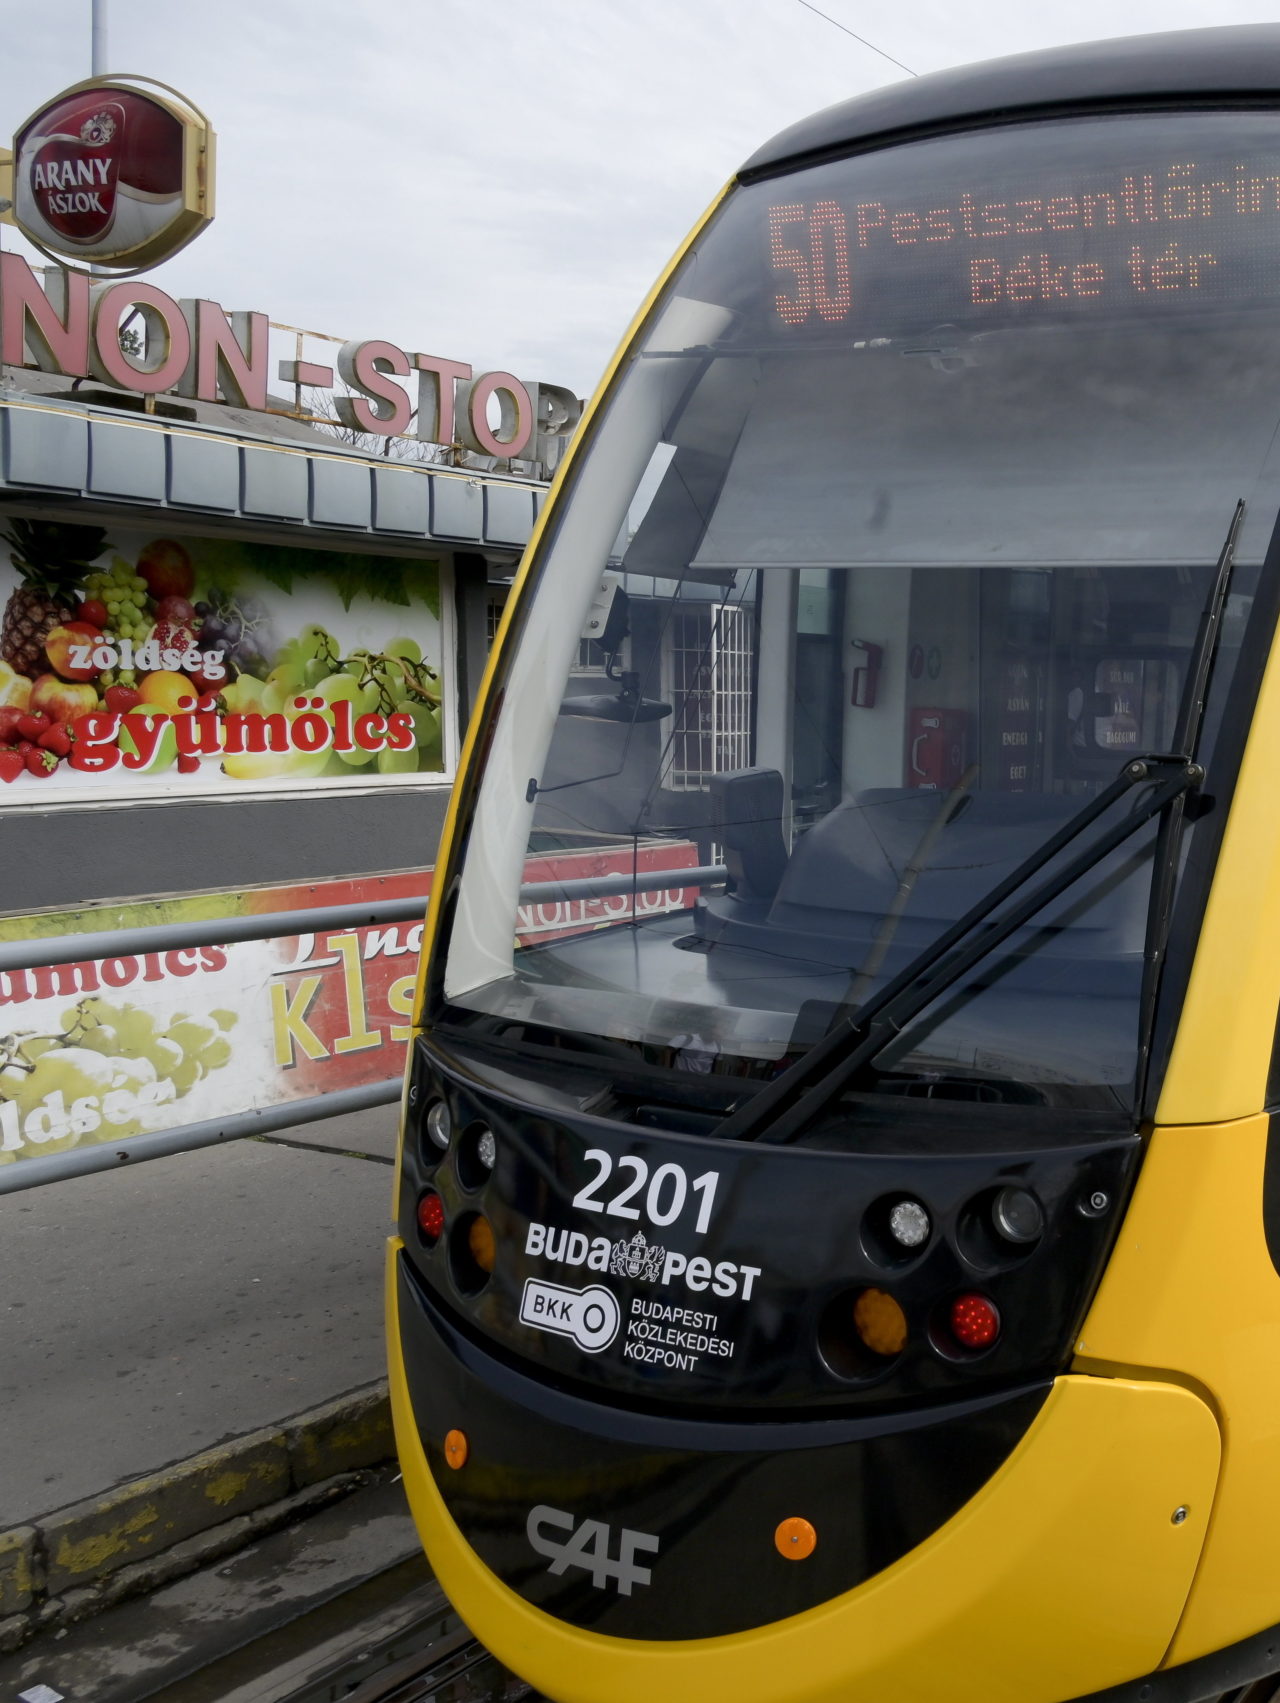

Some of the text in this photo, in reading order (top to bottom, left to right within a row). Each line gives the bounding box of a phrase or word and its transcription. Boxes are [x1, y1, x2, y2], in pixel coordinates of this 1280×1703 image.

[35, 159, 112, 191] ARANY
[47, 190, 108, 215] ÁSZOK
[768, 200, 852, 324] 50
[970, 242, 1217, 304] Béke tér
[68, 637, 226, 680] zöldség
[67, 695, 416, 774] gyümölcs
[572, 1149, 720, 1235] 2201
[533, 1294, 574, 1322] BKK
[631, 1298, 718, 1331] BUDAPESTI
[623, 1341, 699, 1372] KÖZPONT
[627, 1319, 735, 1358] KÖZLEKEDÉSI
[525, 1503, 660, 1597] CAF
